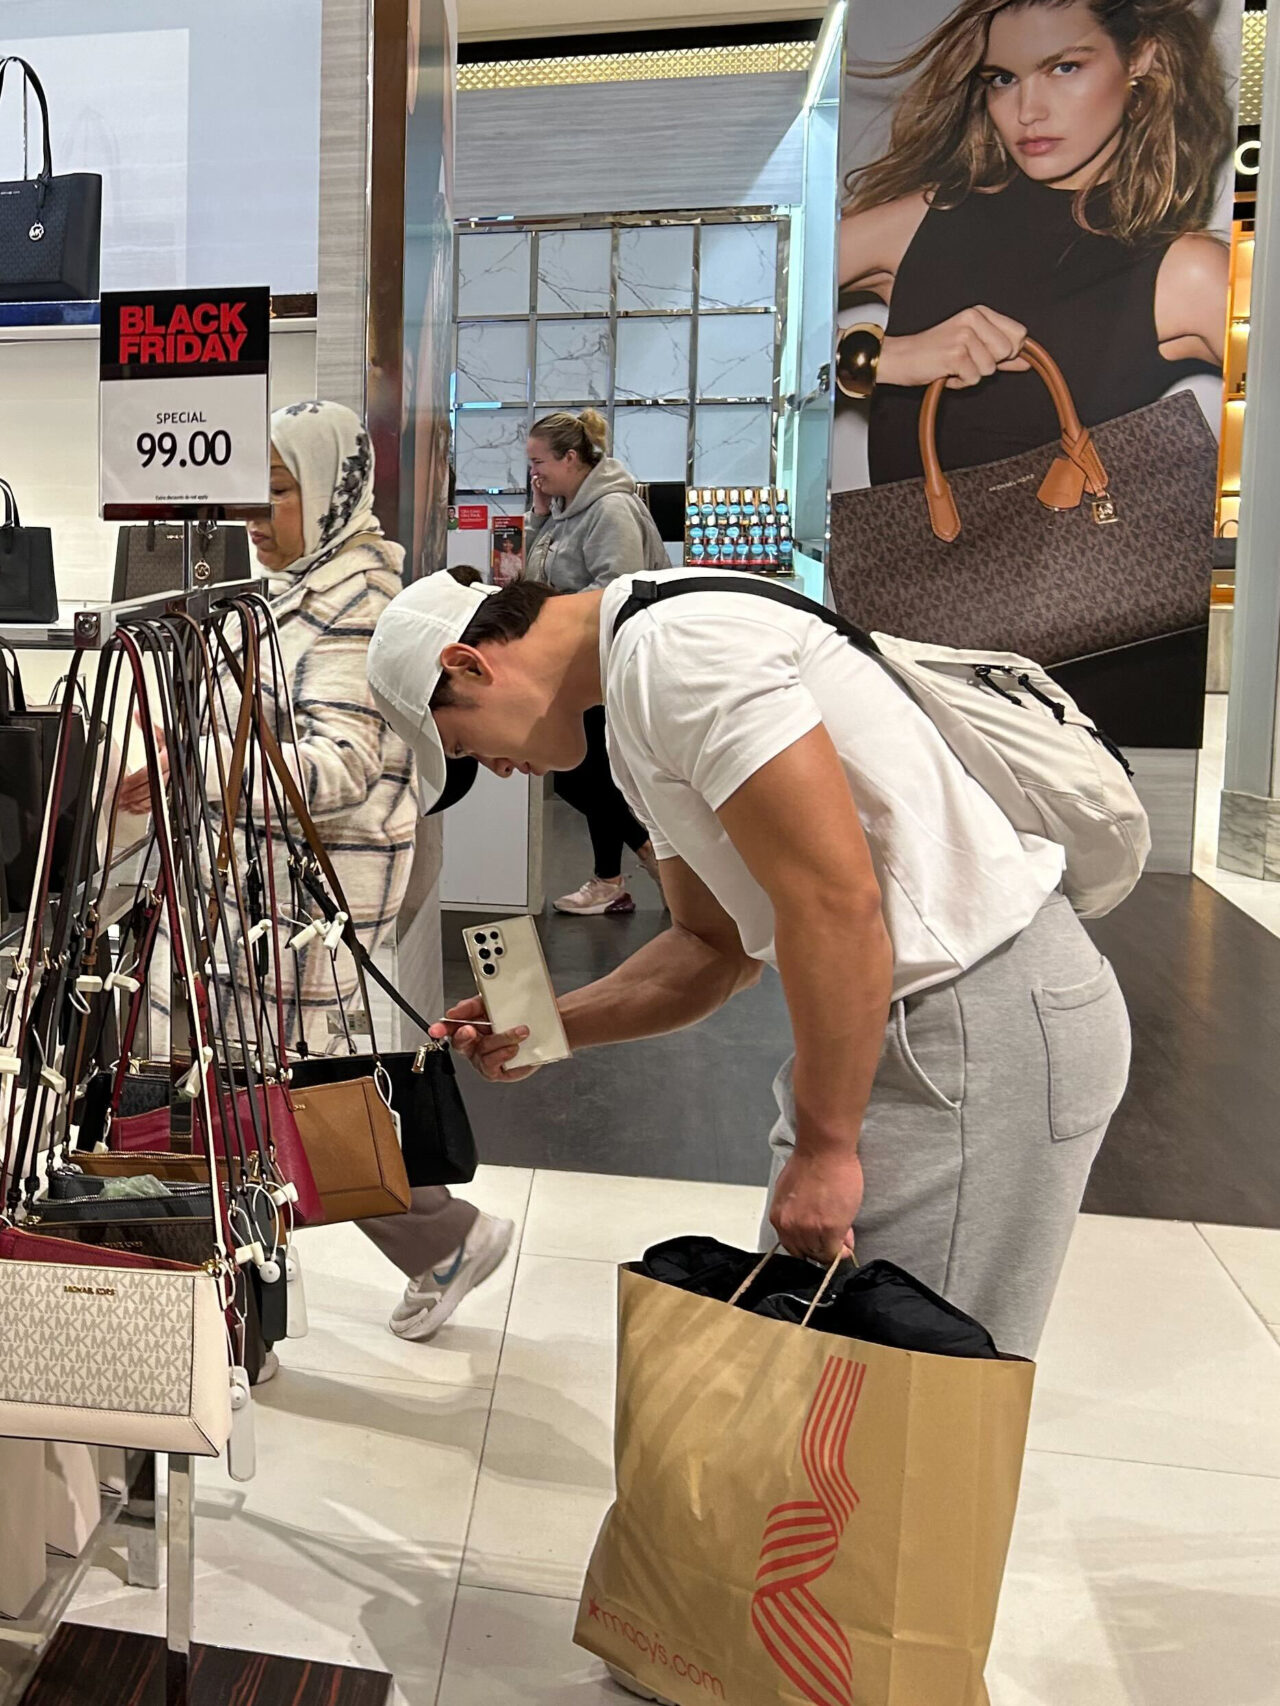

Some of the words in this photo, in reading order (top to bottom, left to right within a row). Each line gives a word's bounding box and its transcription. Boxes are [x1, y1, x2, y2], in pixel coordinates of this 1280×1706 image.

[120, 302, 248, 335] BLACK
[120, 332, 248, 365] FRIDAY
[156, 411, 207, 425] SPECIAL
[136, 429, 232, 468] 99.00
[600, 1609, 726, 1701] macy's.com
